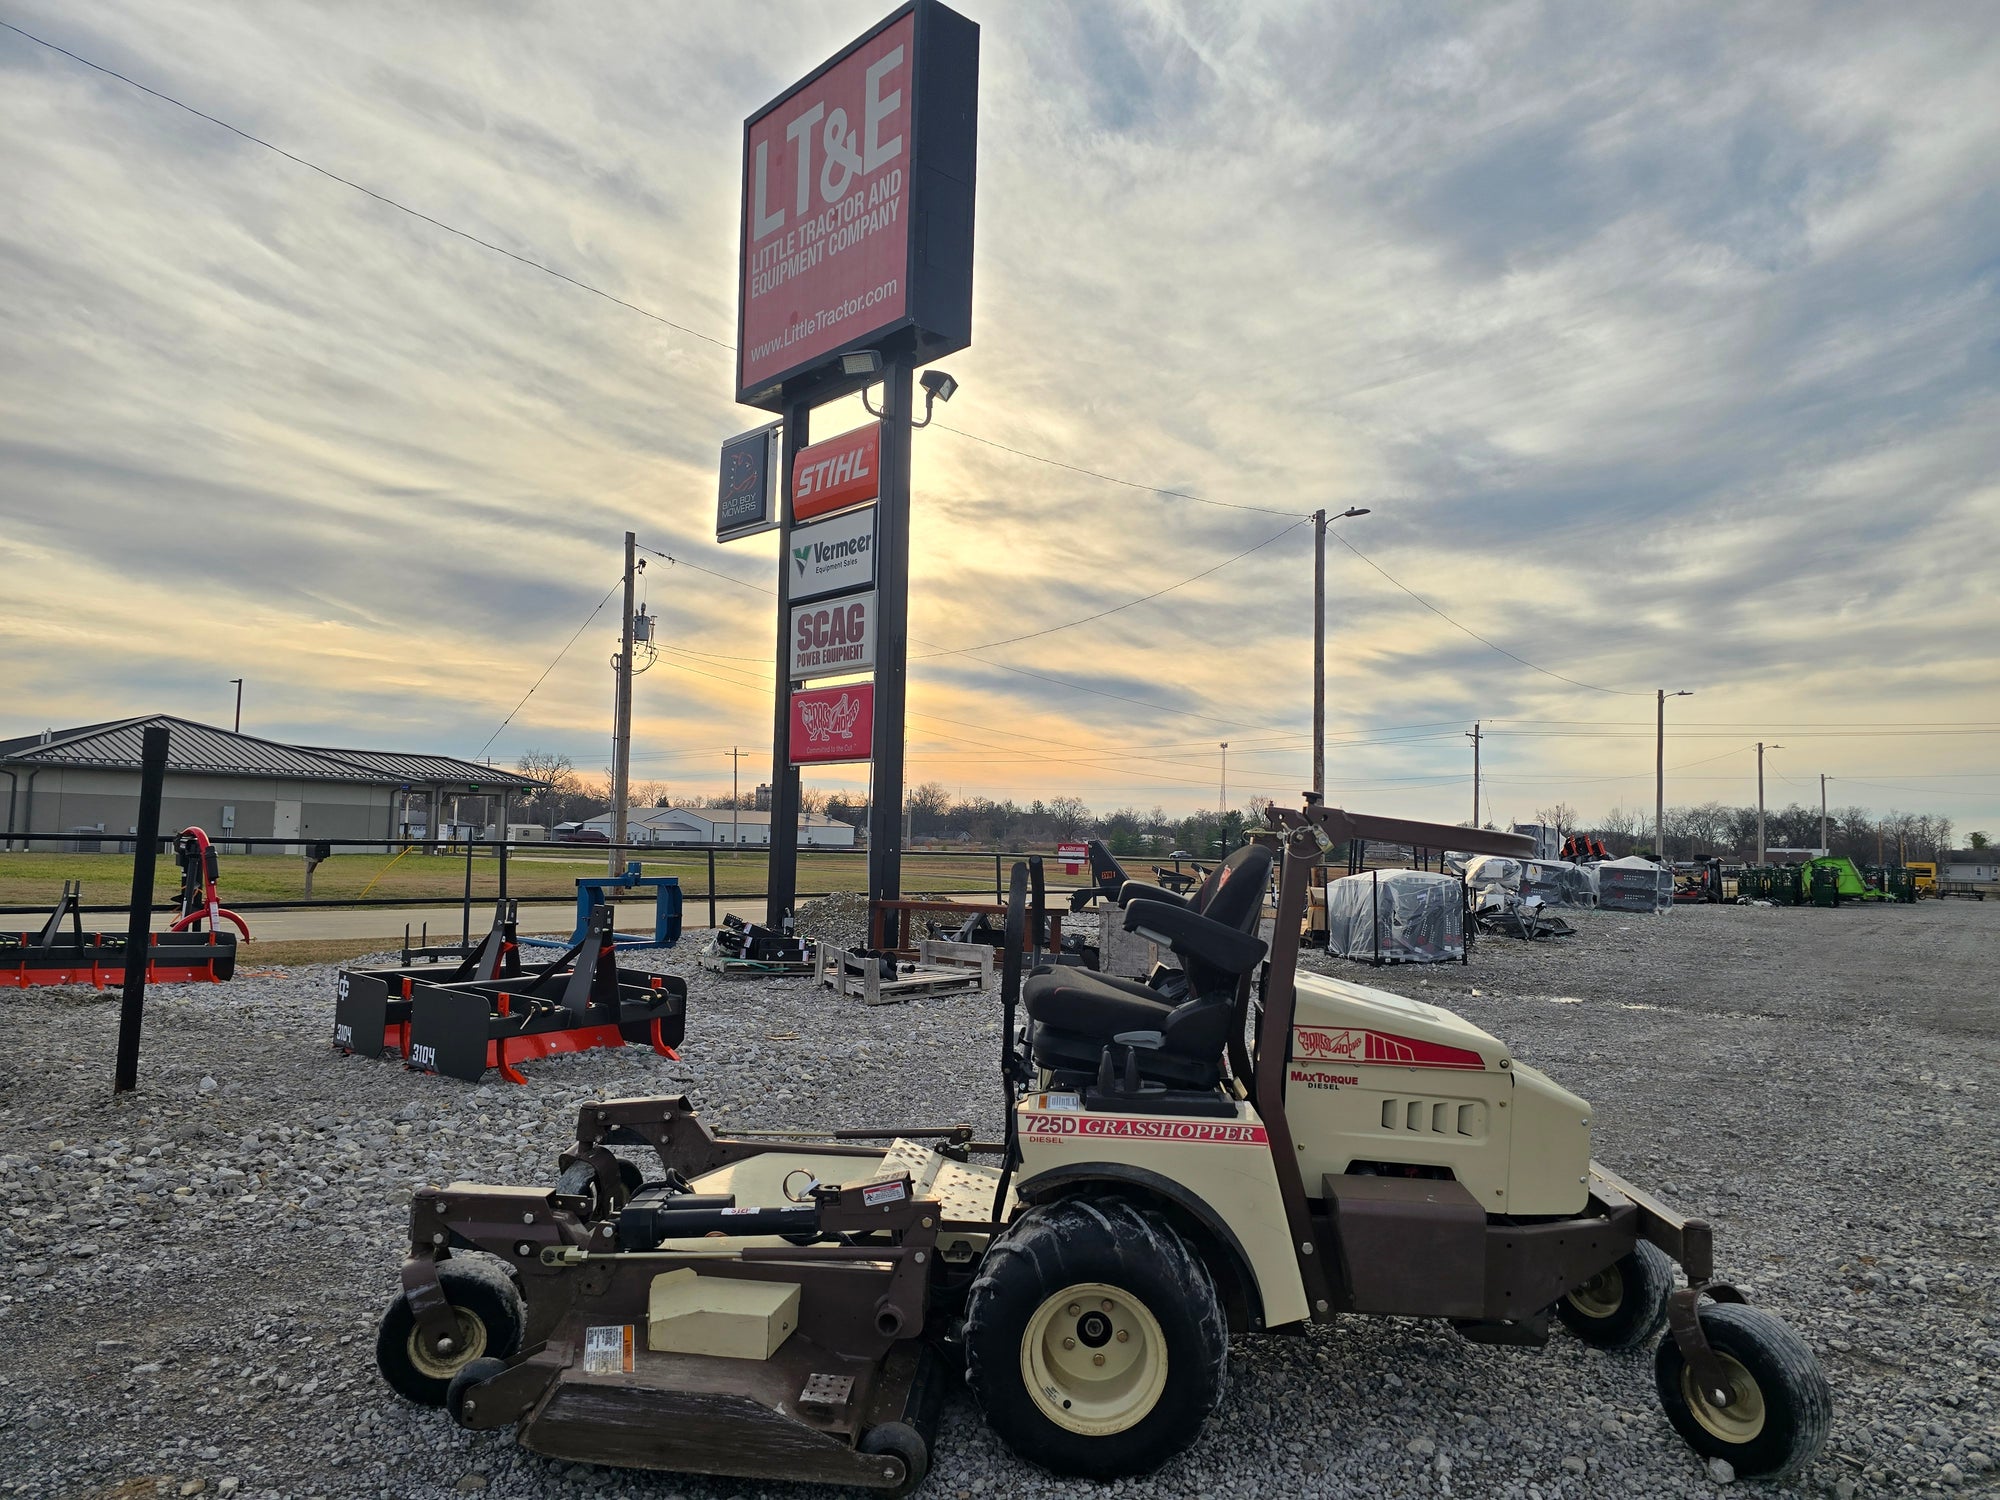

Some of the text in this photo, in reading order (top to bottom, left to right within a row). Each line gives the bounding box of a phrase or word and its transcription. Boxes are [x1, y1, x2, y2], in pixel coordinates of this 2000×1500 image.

[754, 44, 904, 242] LT&E
[752, 168, 902, 276] LITTLE TRACTOR AND
[751, 196, 900, 299] EQUIPMENT COMPANY
[751, 278, 898, 363] www.LittleTractor.com
[796, 446, 870, 498] STIHL
[721, 501, 757, 518] MOWERS
[722, 493, 757, 510] BAD BOY
[813, 534, 872, 564] Vermeer
[815, 558, 858, 575] Equipment Sales
[797, 602, 865, 652] SCAG
[796, 644, 864, 669] POWER EQUIPMENT
[336, 1023, 353, 1043] 3104
[412, 1043, 436, 1066] 3104
[1307, 1082, 1340, 1091] DIESEL
[1025, 1115, 1255, 1141] 725D GRASSHOPPER
[1028, 1135, 1064, 1144] DIESEL
